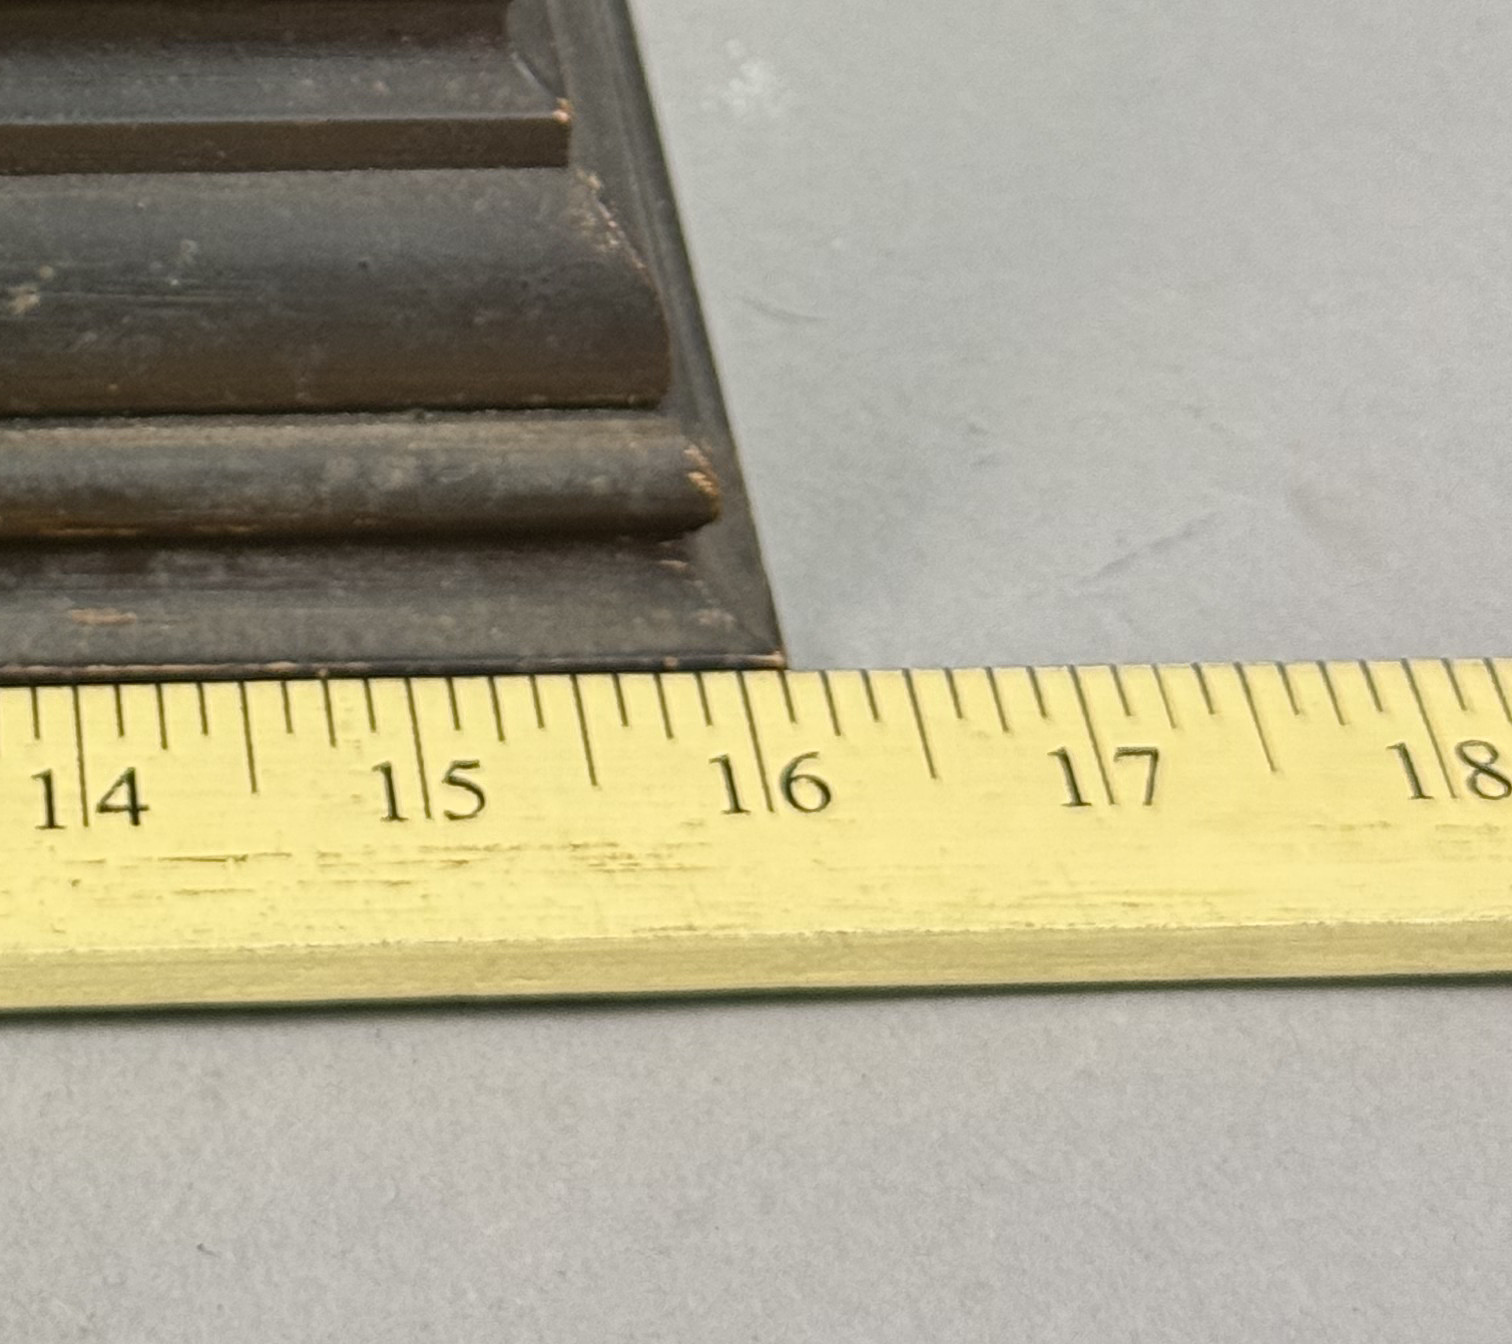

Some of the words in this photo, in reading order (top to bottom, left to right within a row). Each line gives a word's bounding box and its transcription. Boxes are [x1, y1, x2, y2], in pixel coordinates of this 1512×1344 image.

[31, 767, 151, 832] 14
[372, 759, 488, 824] 15
[709, 751, 833, 816] 16
[1046, 745, 1161, 809] 17
[1385, 739, 1512, 801] 18
